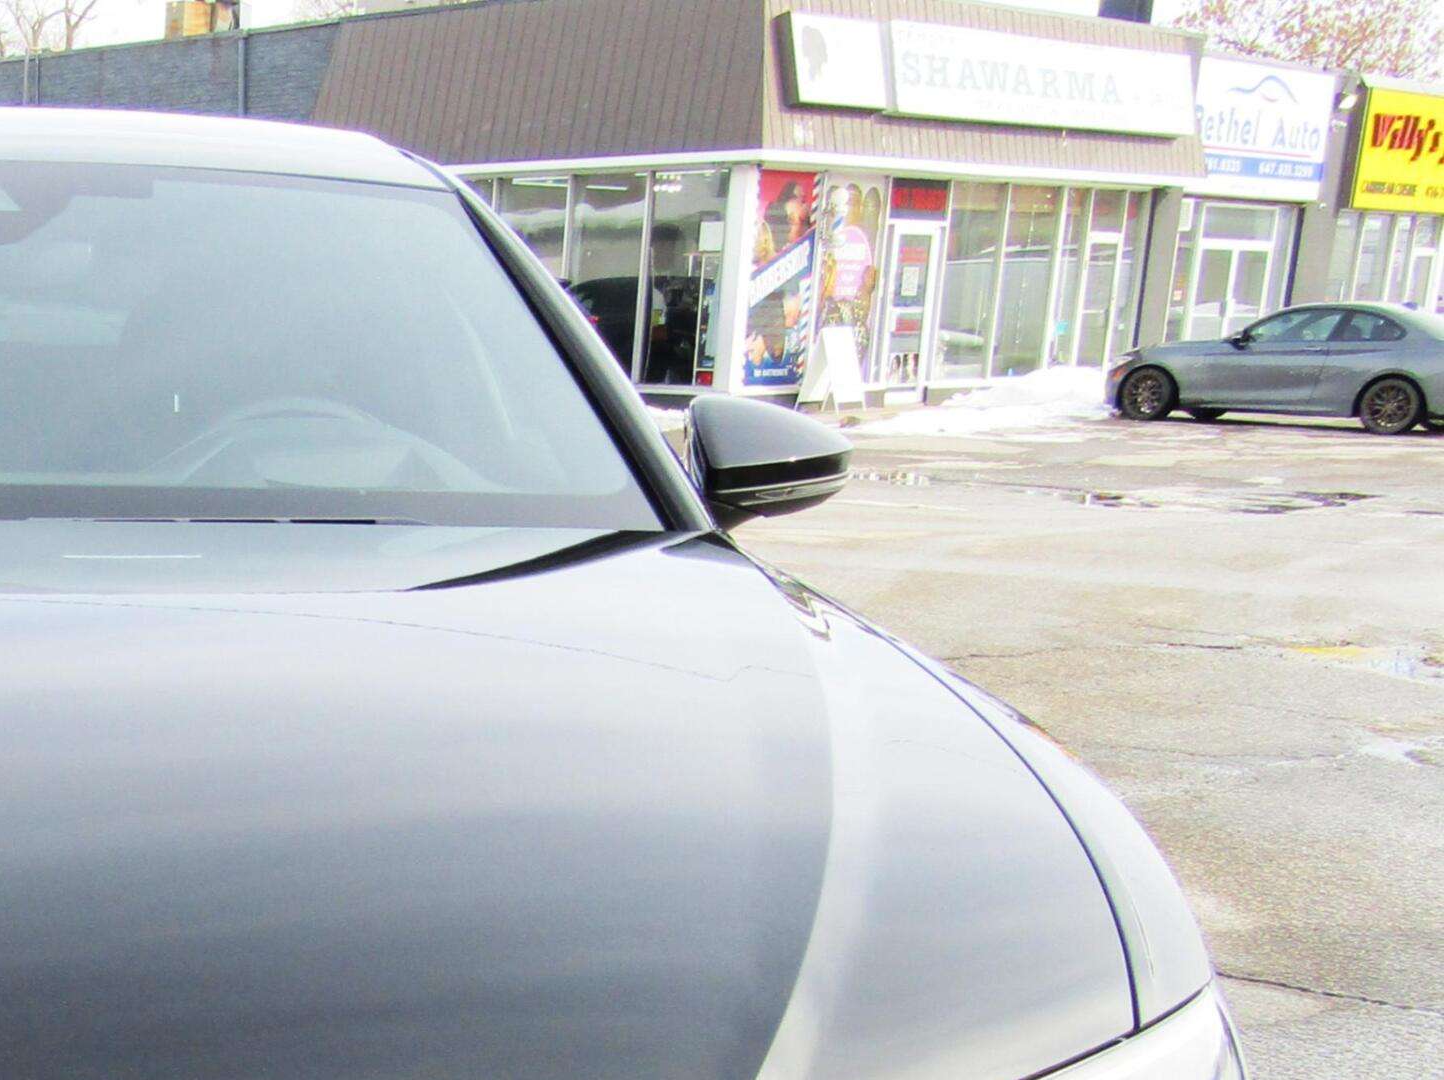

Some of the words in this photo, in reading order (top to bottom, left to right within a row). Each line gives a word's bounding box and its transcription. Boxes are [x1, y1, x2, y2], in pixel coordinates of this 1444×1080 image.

[899, 49, 1124, 106] SHAWARMA
[1271, 117, 1321, 151] Auto
[1371, 113, 1442, 162] Willy's
